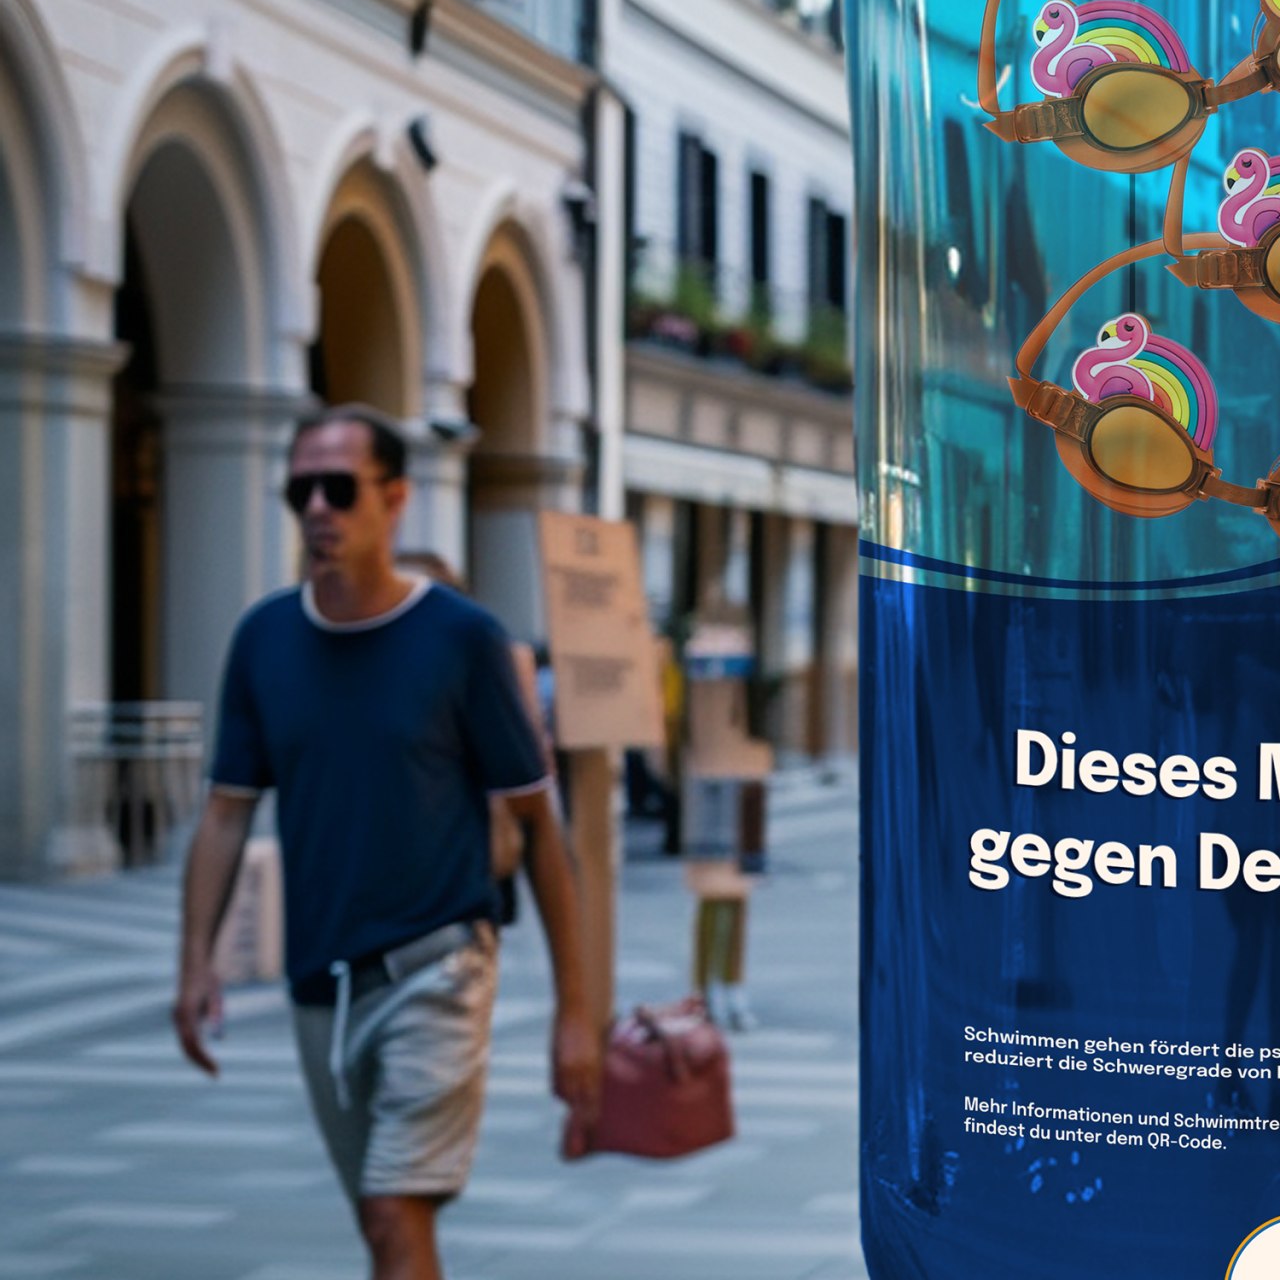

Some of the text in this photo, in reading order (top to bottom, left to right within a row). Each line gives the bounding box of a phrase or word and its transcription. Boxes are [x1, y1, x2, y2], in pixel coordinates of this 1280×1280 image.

[1016, 729, 1237, 800] Dieses
[968, 828, 1177, 898] gegen
[964, 1025, 1079, 1050] Schwimmen
[1084, 1036, 1144, 1055] gehen
[1148, 1039, 1220, 1057] fördert
[1224, 1042, 1255, 1058] die
[964, 1049, 1054, 1069] reduziert
[1058, 1055, 1088, 1071] die
[1092, 1057, 1233, 1080] Schweregrade
[1237, 1068, 1272, 1079] von
[964, 1095, 1008, 1114] Mehr
[1012, 1101, 1133, 1125] Informationen
[1138, 1111, 1170, 1127] und
[963, 1116, 1227, 1150] findest du unter dem QR-Code.
